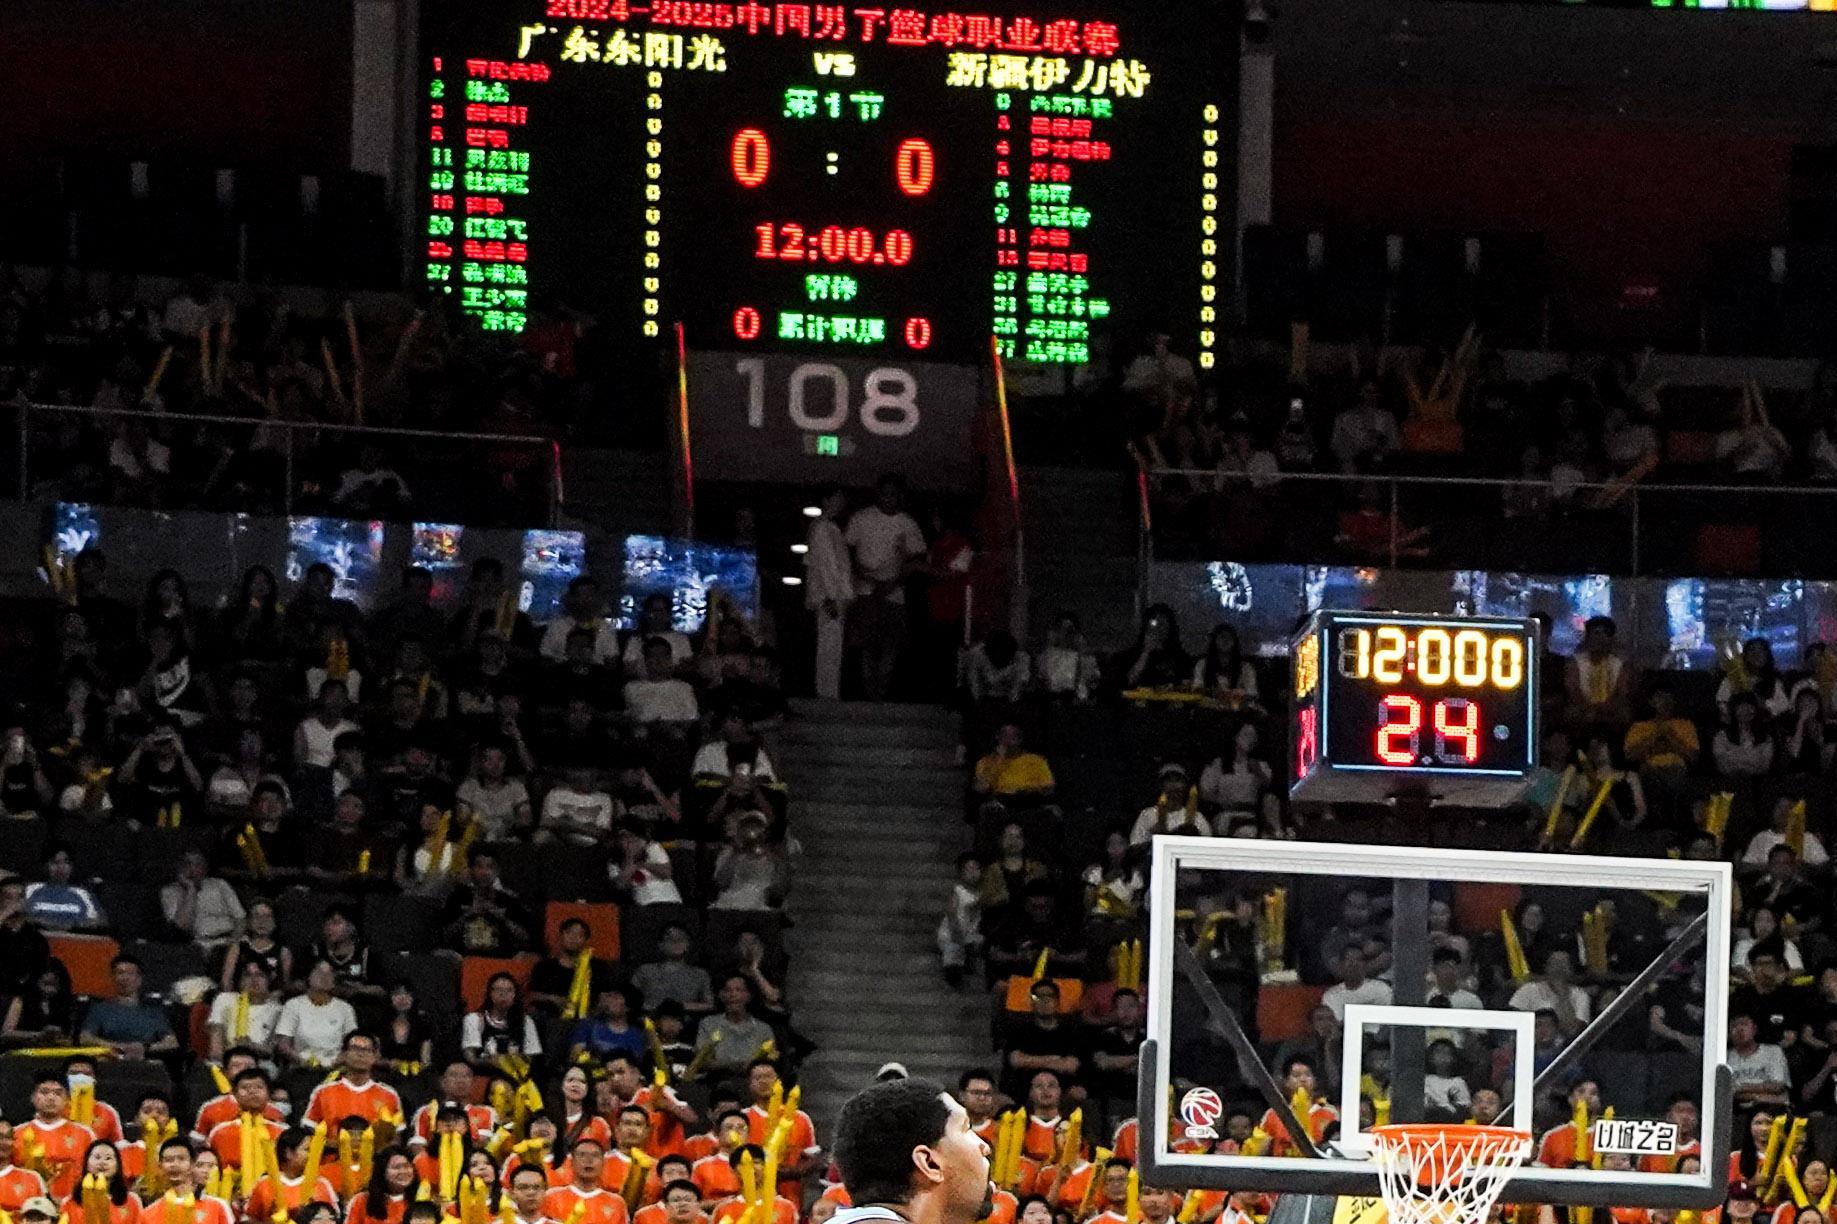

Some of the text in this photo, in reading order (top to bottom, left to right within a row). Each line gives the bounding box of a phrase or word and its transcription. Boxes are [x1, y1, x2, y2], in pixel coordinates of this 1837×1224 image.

[947, 50, 1150, 98] 新疆伊力特
[731, 128, 770, 188] 0
[896, 138, 935, 196] 0
[756, 222, 913, 267] 12:00.0
[734, 306, 761, 340] 0
[905, 317, 931, 350] 0
[736, 358, 920, 436] 108
[1376, 695, 1481, 766] 24
